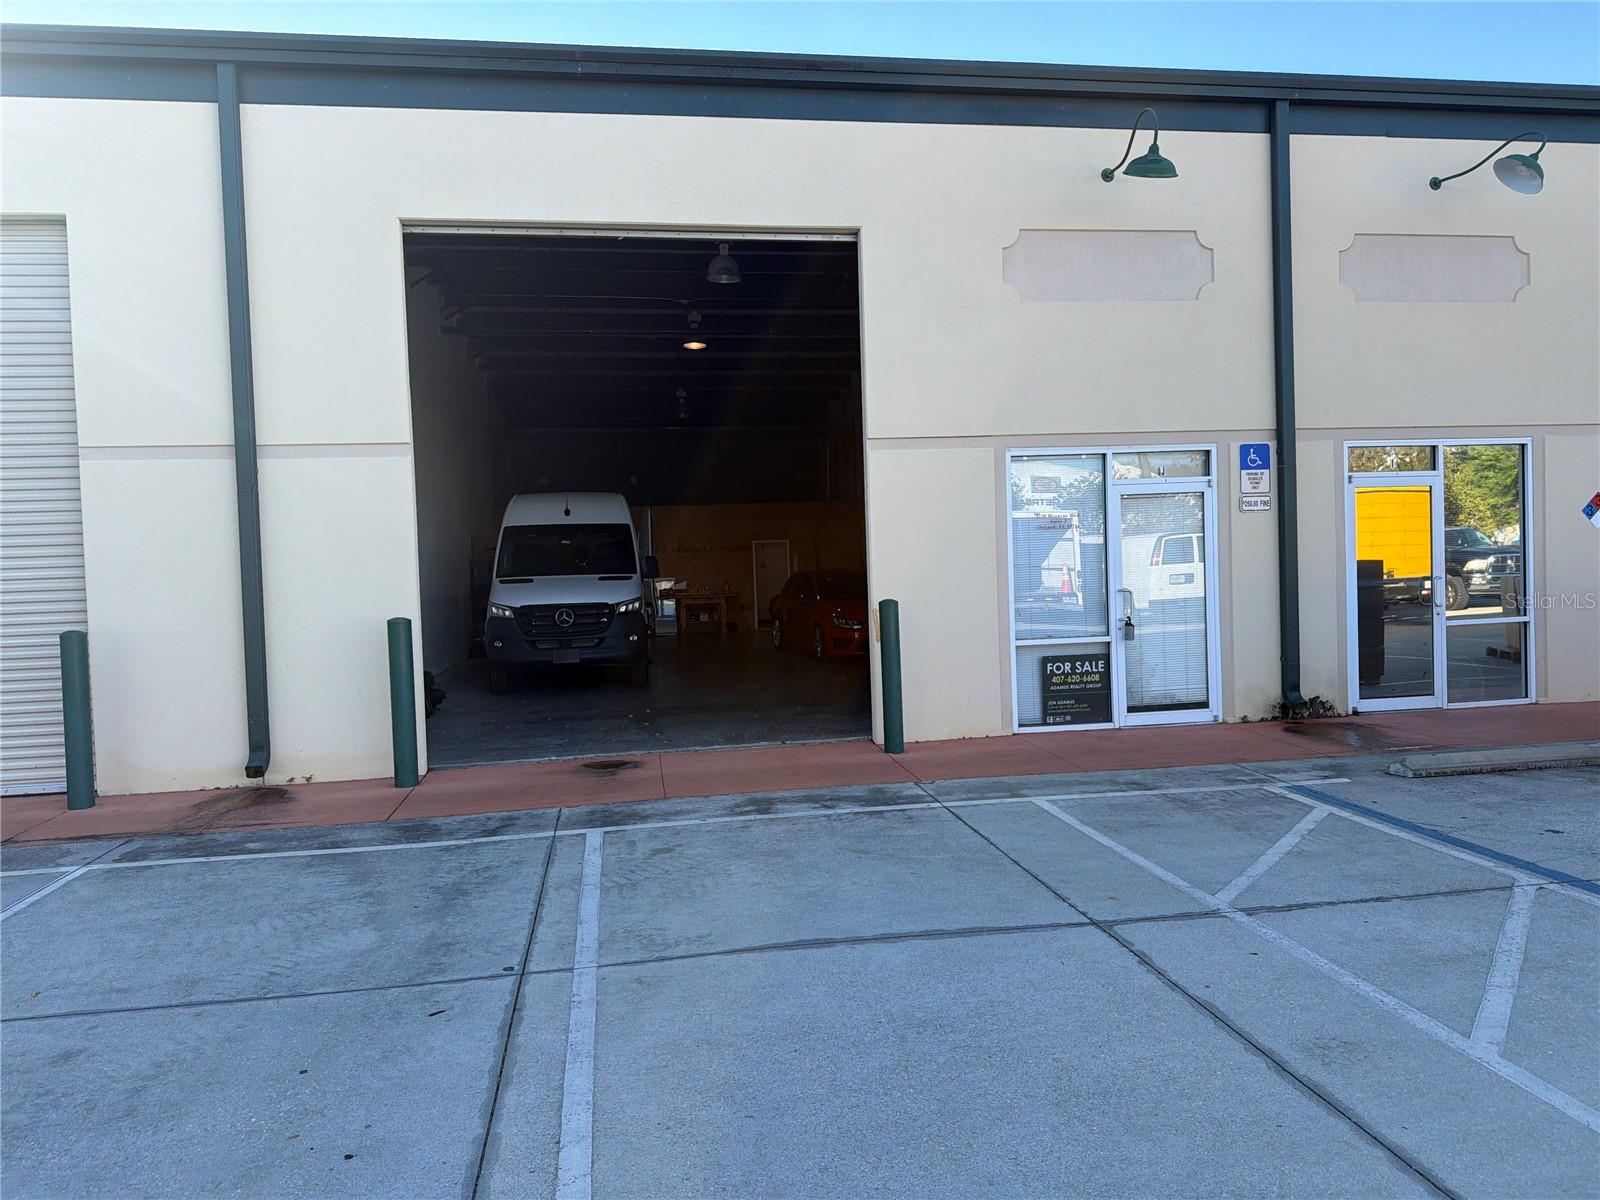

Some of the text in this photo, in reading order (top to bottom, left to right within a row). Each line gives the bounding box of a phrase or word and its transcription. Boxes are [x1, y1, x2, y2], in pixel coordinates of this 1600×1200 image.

[1586, 504, 1594, 516] 3
[1047, 661, 1104, 674] FOR SALE
[1052, 674, 1100, 683] 407-620-6608
